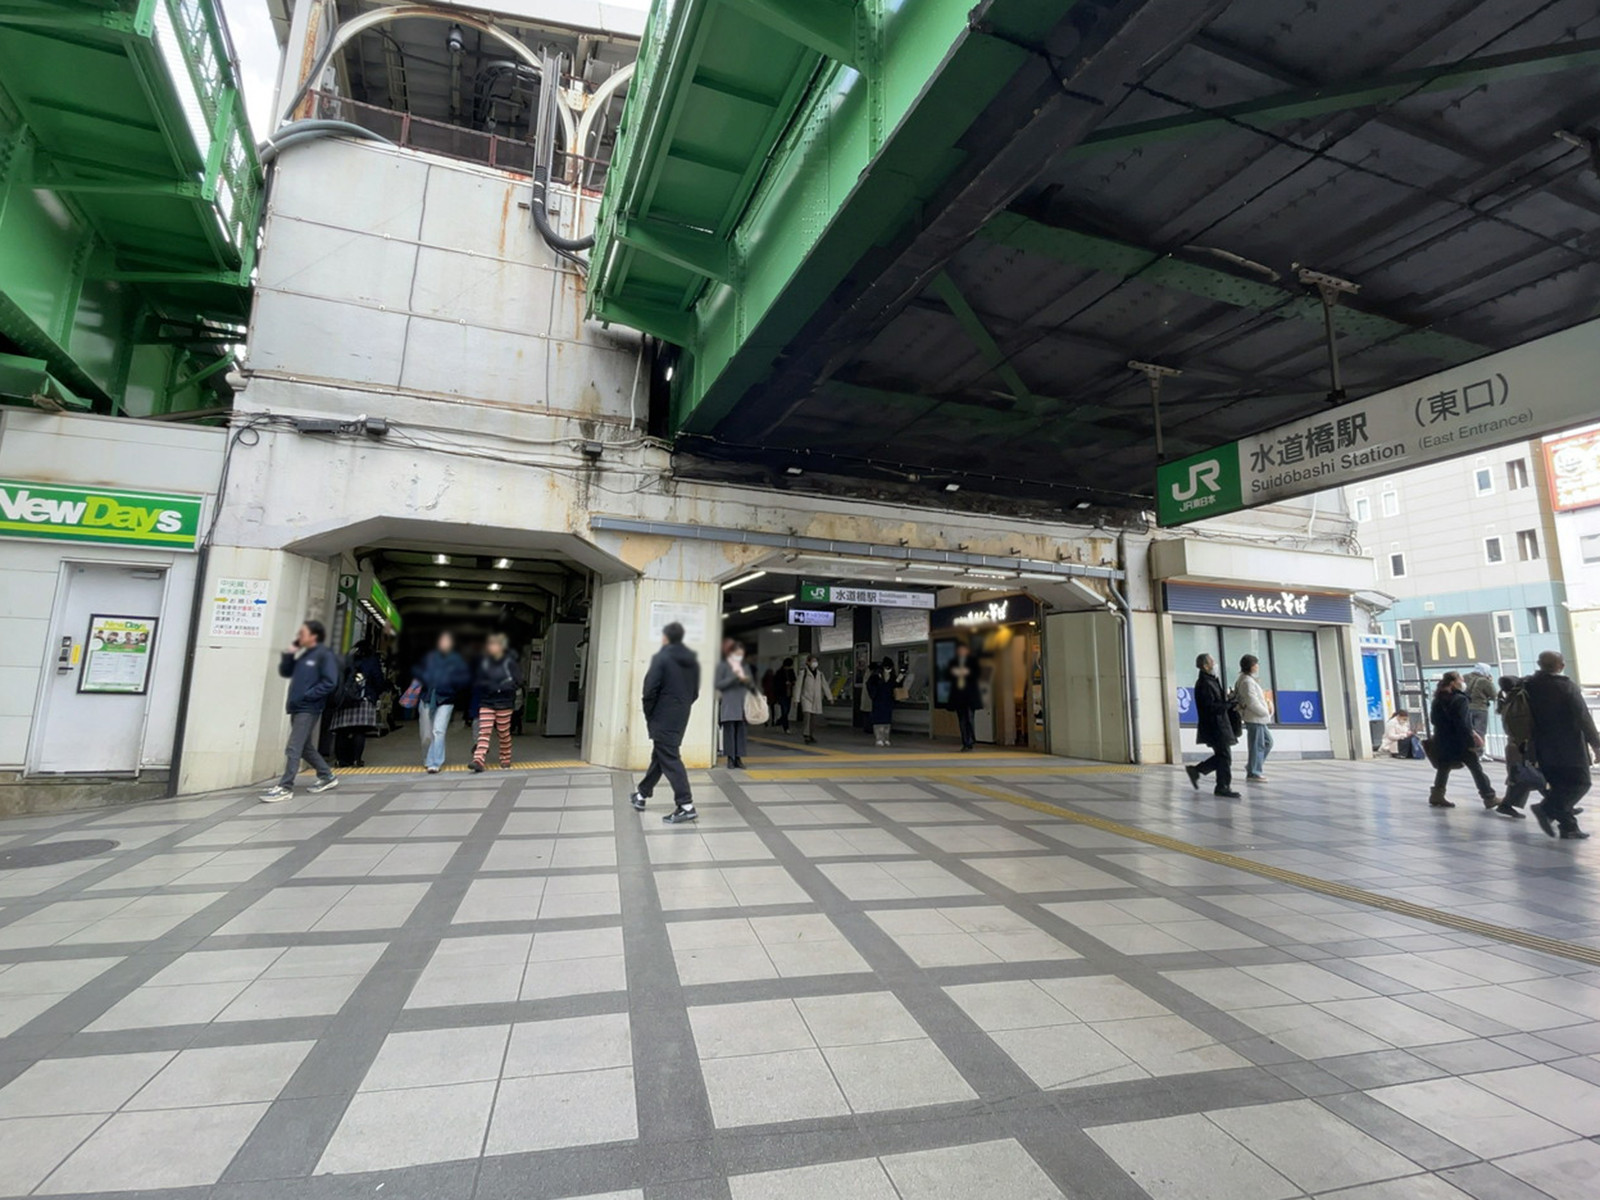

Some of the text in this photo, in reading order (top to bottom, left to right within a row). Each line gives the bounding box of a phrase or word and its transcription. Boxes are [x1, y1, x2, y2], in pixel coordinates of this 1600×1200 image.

[1415, 373, 1508, 427] (東口)
[1250, 411, 1369, 473] 水道橋駅
[1418, 408, 1534, 450] (East Entrance)
[1172, 459, 1221, 501] JR
[1251, 443, 1406, 493] Suidōbashi Station
[0, 488, 183, 534] NewDays
[811, 588, 825, 597] JR
[835, 589, 877, 603] 水道橋駅
